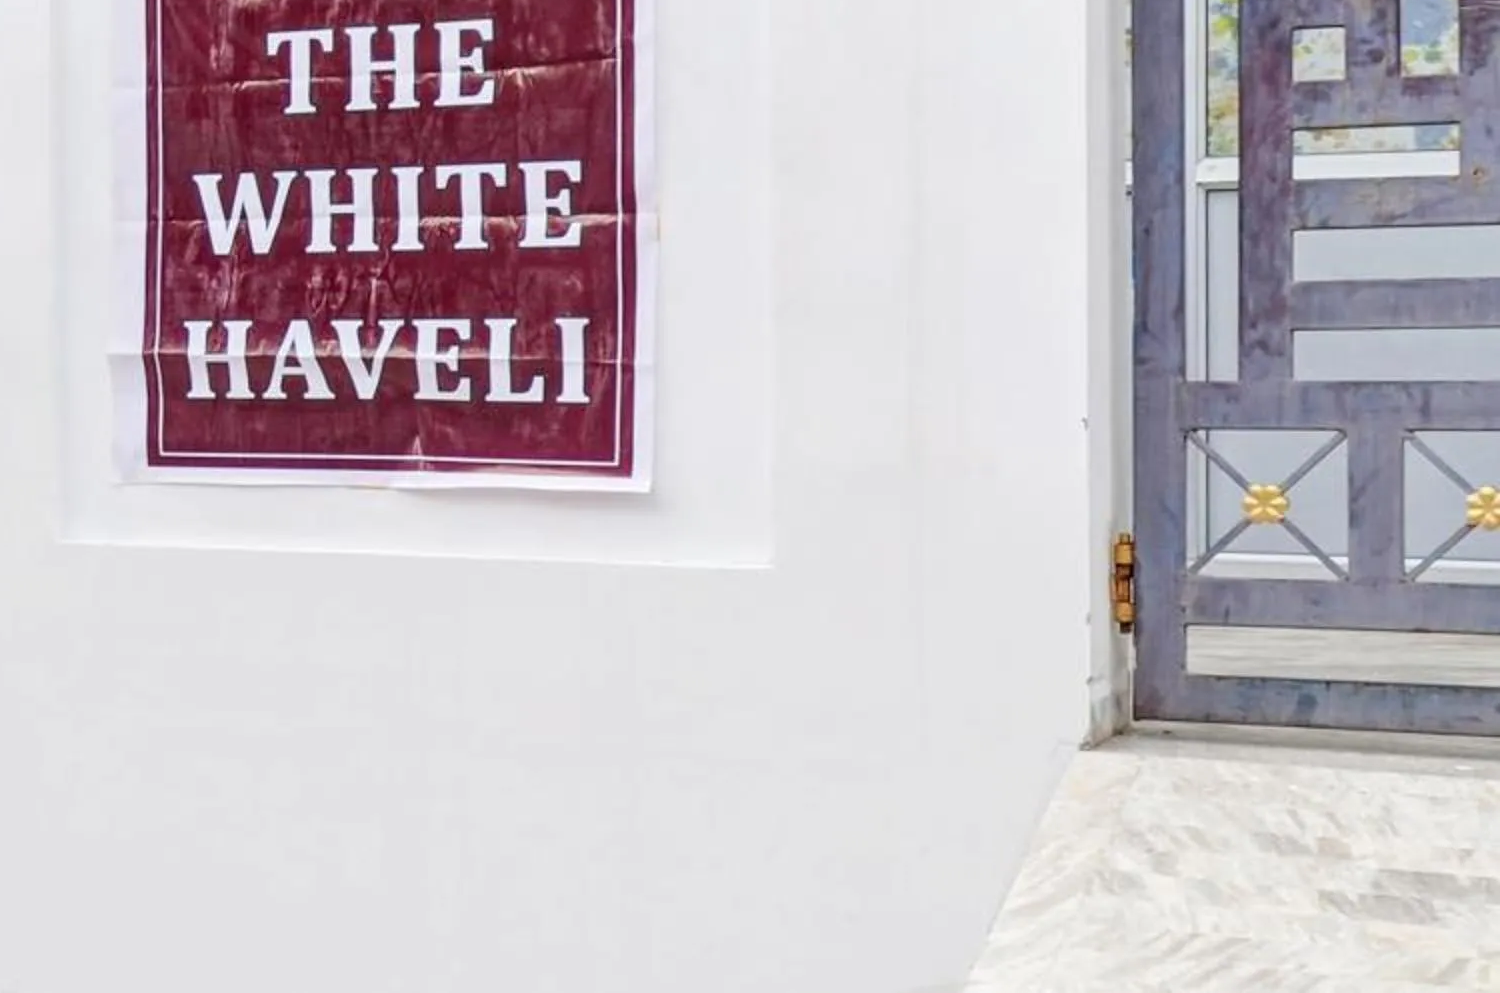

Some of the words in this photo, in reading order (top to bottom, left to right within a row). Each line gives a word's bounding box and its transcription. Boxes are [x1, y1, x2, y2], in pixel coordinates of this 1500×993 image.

[266, 18, 495, 114] THE
[192, 160, 582, 255] WHITE
[183, 317, 590, 403] HAVELI
